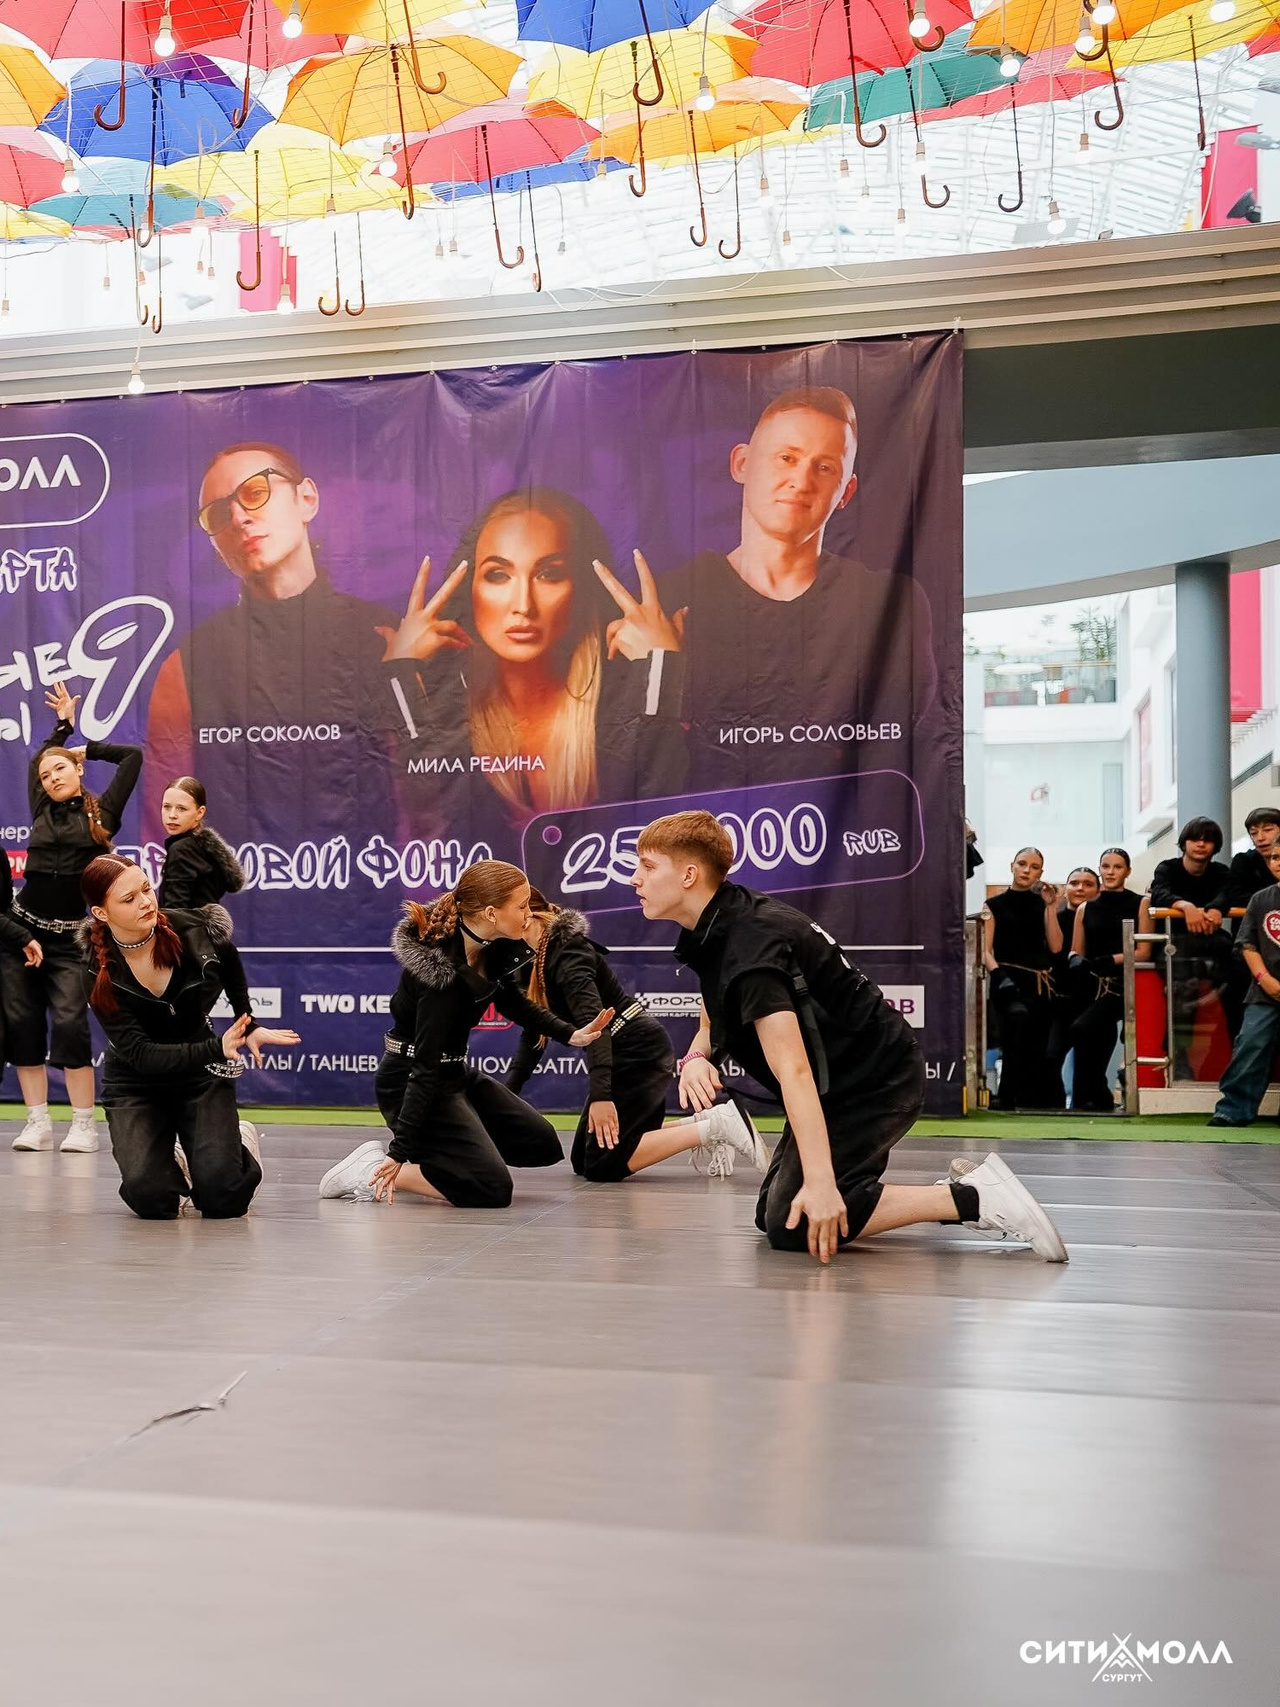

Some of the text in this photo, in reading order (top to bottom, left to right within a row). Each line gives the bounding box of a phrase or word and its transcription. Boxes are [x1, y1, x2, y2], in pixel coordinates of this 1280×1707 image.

[199, 723, 342, 744] ЕГОР СОКОЛОВ
[719, 722, 902, 745] ИГОРЬ СОЛОВЬЕВ
[407, 754, 546, 775] МИЛА РЕДИНА
[842, 828, 902, 857] RUB
[559, 824, 646, 894] 25
[300, 994, 355, 1014] TWO
